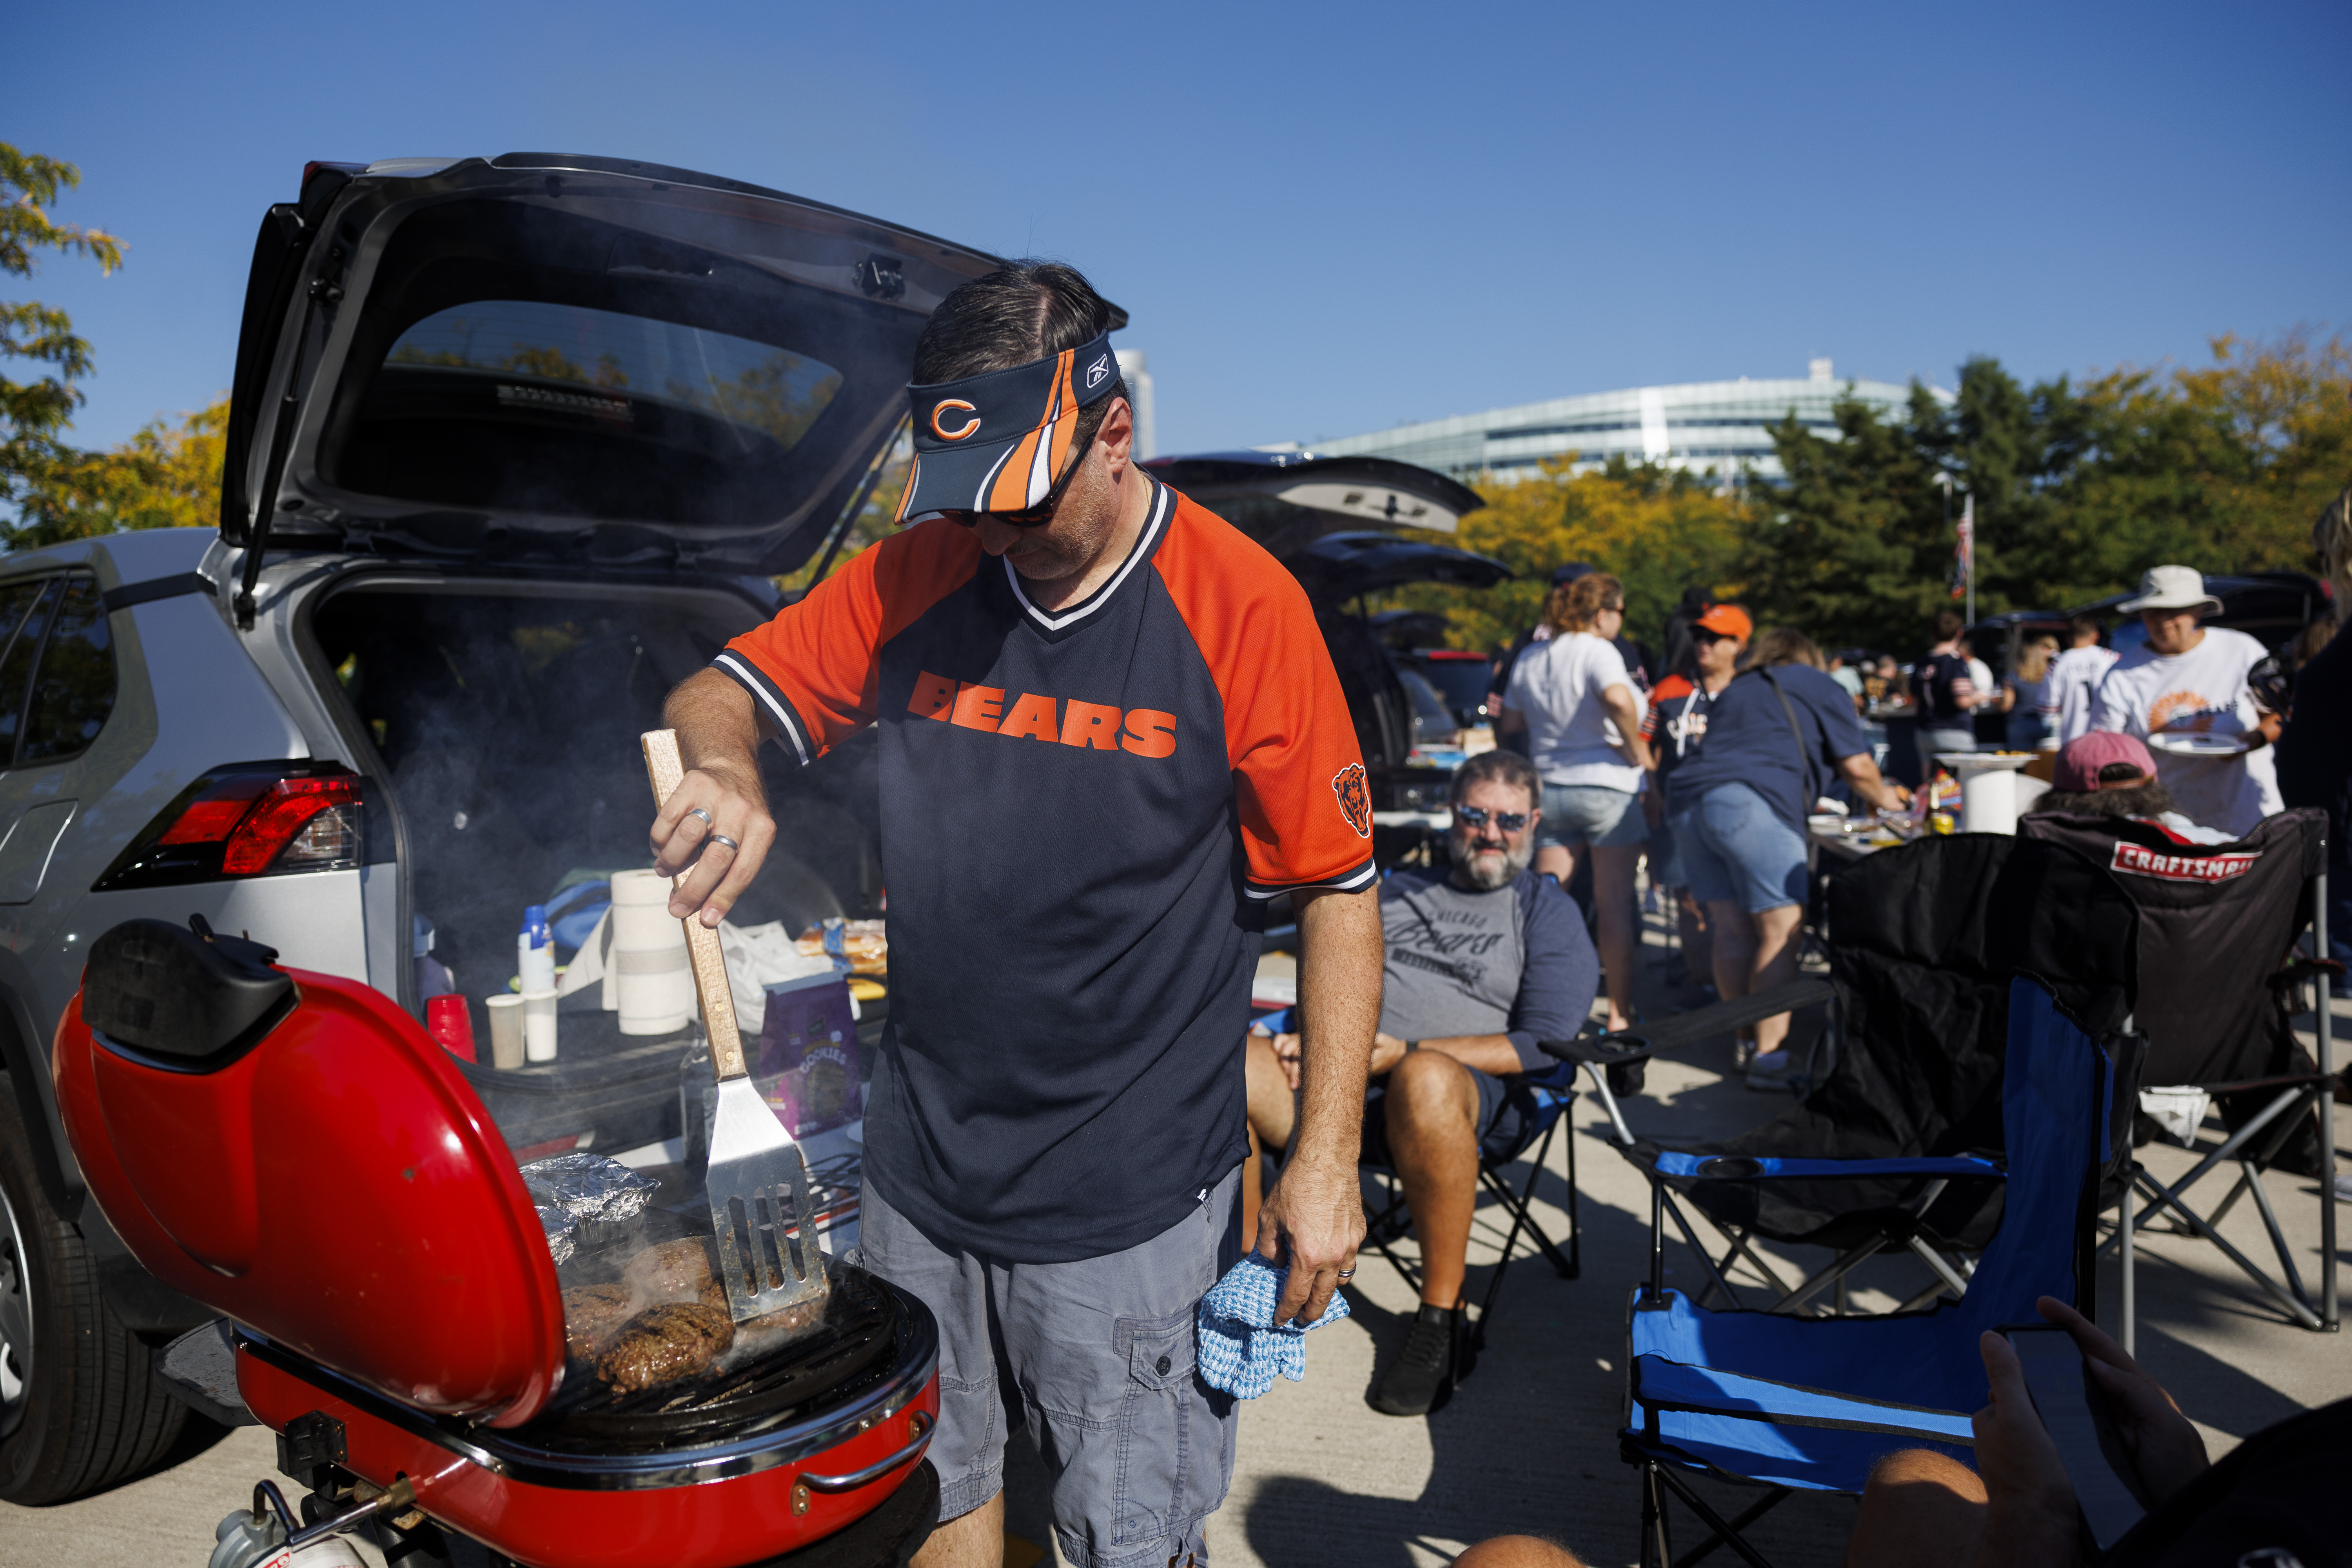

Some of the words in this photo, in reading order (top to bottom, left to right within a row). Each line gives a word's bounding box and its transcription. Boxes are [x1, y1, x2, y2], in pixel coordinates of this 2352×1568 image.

[930, 399, 980, 442] C
[907, 670, 1176, 758] BEARS
[799, 1046, 847, 1074] COOKIES
